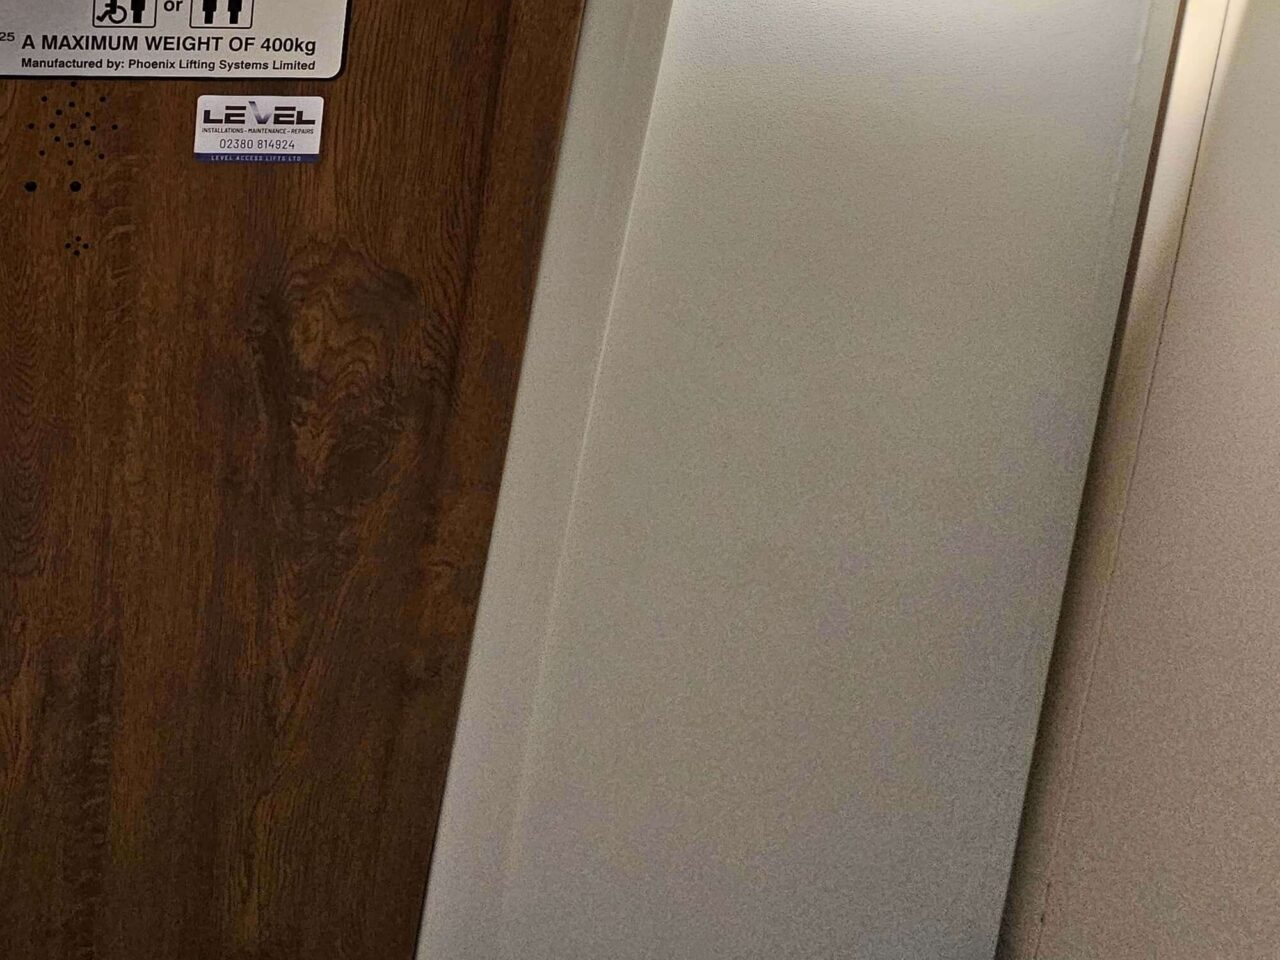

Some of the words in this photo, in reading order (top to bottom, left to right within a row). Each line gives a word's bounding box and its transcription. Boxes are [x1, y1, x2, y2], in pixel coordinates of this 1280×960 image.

[163, 0, 183, 12] or
[21, 35, 36, 50] A
[41, 35, 138, 51] MAXIMUM
[145, 37, 223, 52] WEIGHT
[229, 37, 255, 52] OF
[260, 38, 316, 56] 400kg
[21, 58, 104, 69] Manufactured
[106, 59, 124, 71] by:
[128, 59, 176, 69] Phoenix
[179, 59, 215, 72] Lifting
[219, 60, 269, 72] Systems
[272, 60, 315, 70] Limited
[203, 101, 316, 125] LEVEL
[220, 139, 253, 148] 02380
[257, 140, 295, 149] 814924
